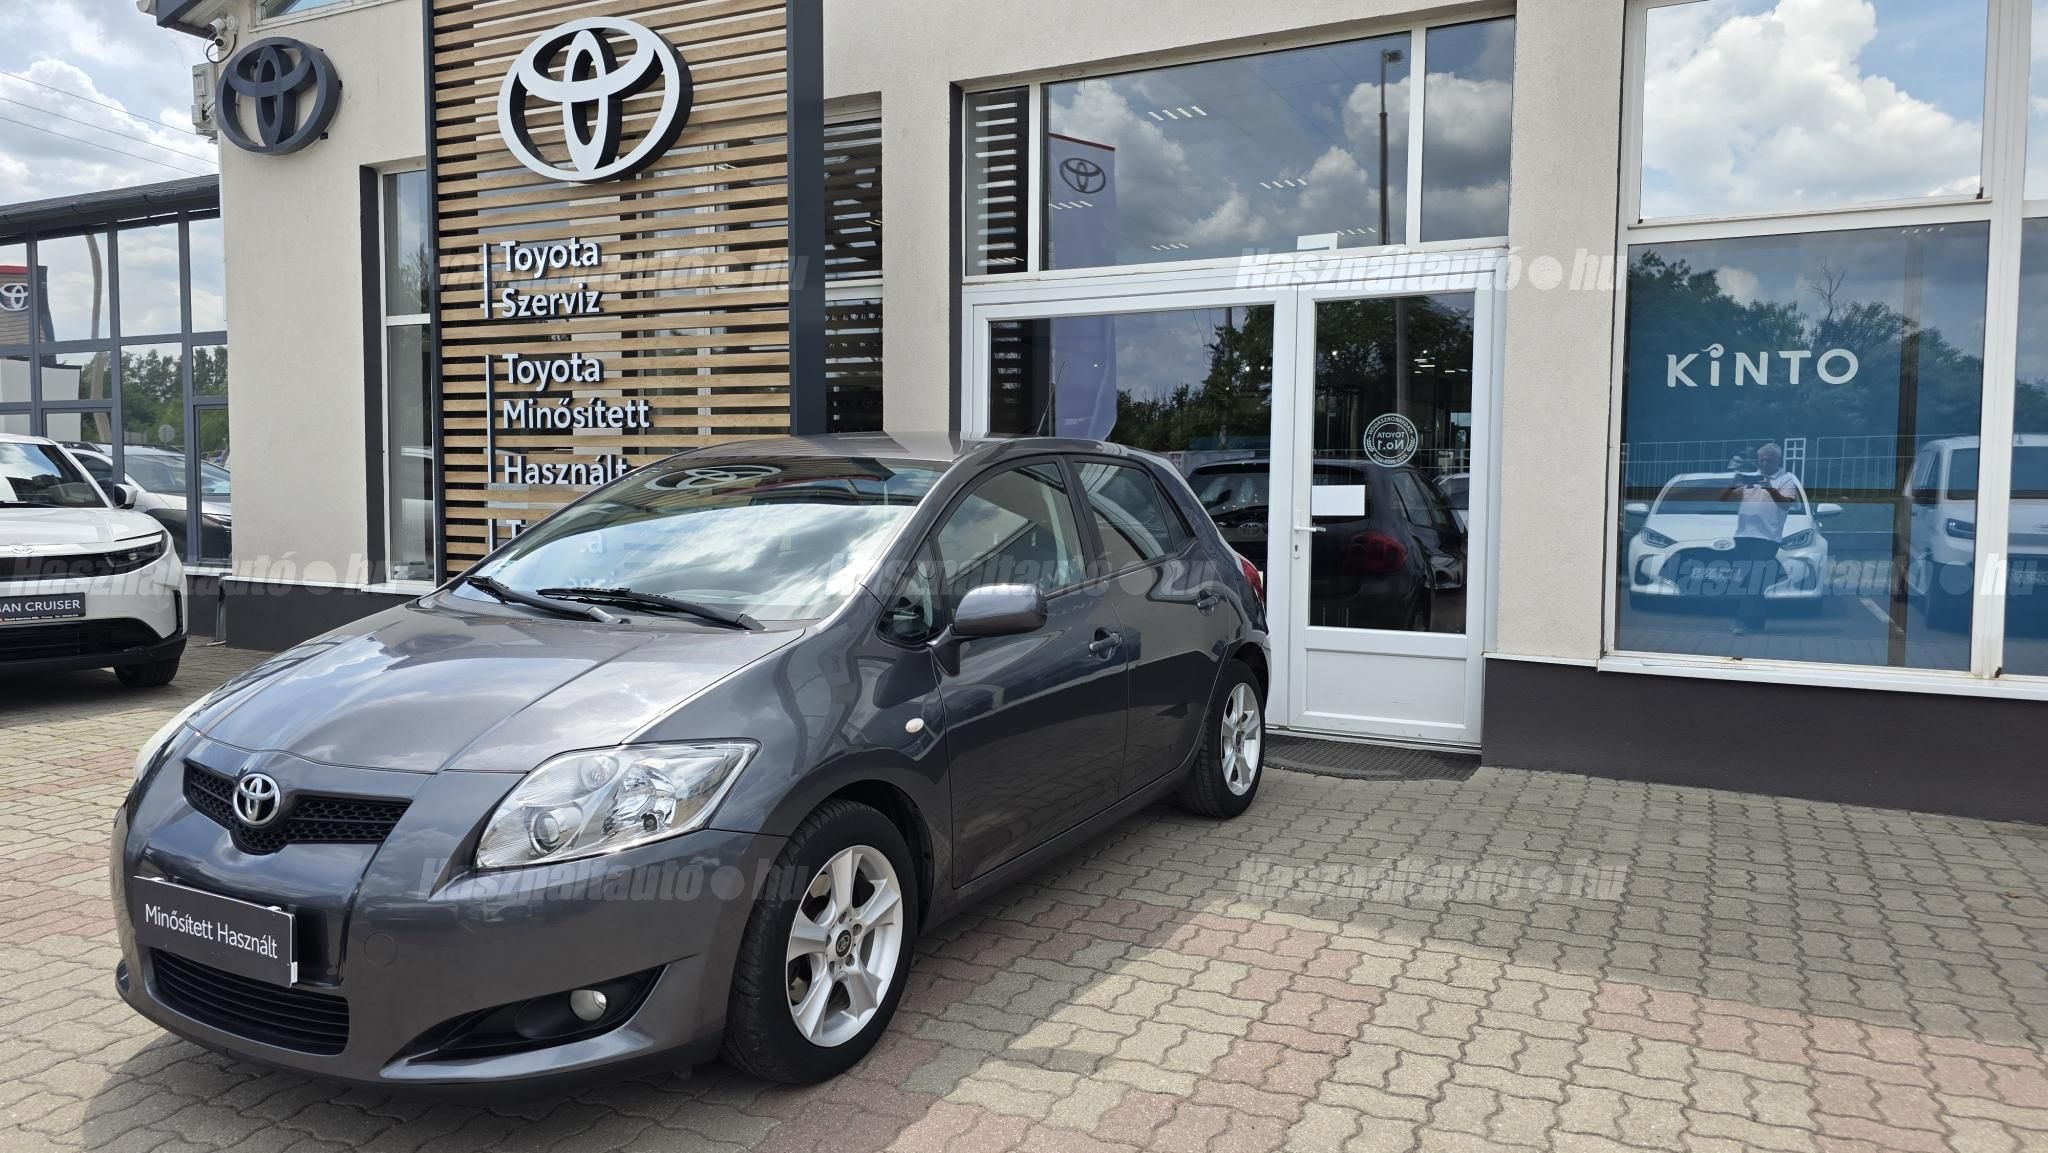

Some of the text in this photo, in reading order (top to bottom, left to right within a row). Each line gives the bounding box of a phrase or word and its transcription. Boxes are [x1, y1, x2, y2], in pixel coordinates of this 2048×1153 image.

[500, 237, 600, 278] Toyota
[501, 283, 601, 318] Szerviz
[502, 352, 601, 392] Toyota
[503, 397, 651, 430] Minősített
[504, 454, 627, 485] Használt
[25, 599, 81, 612] CRUISER
[145, 903, 278, 959] Minősített Használt
